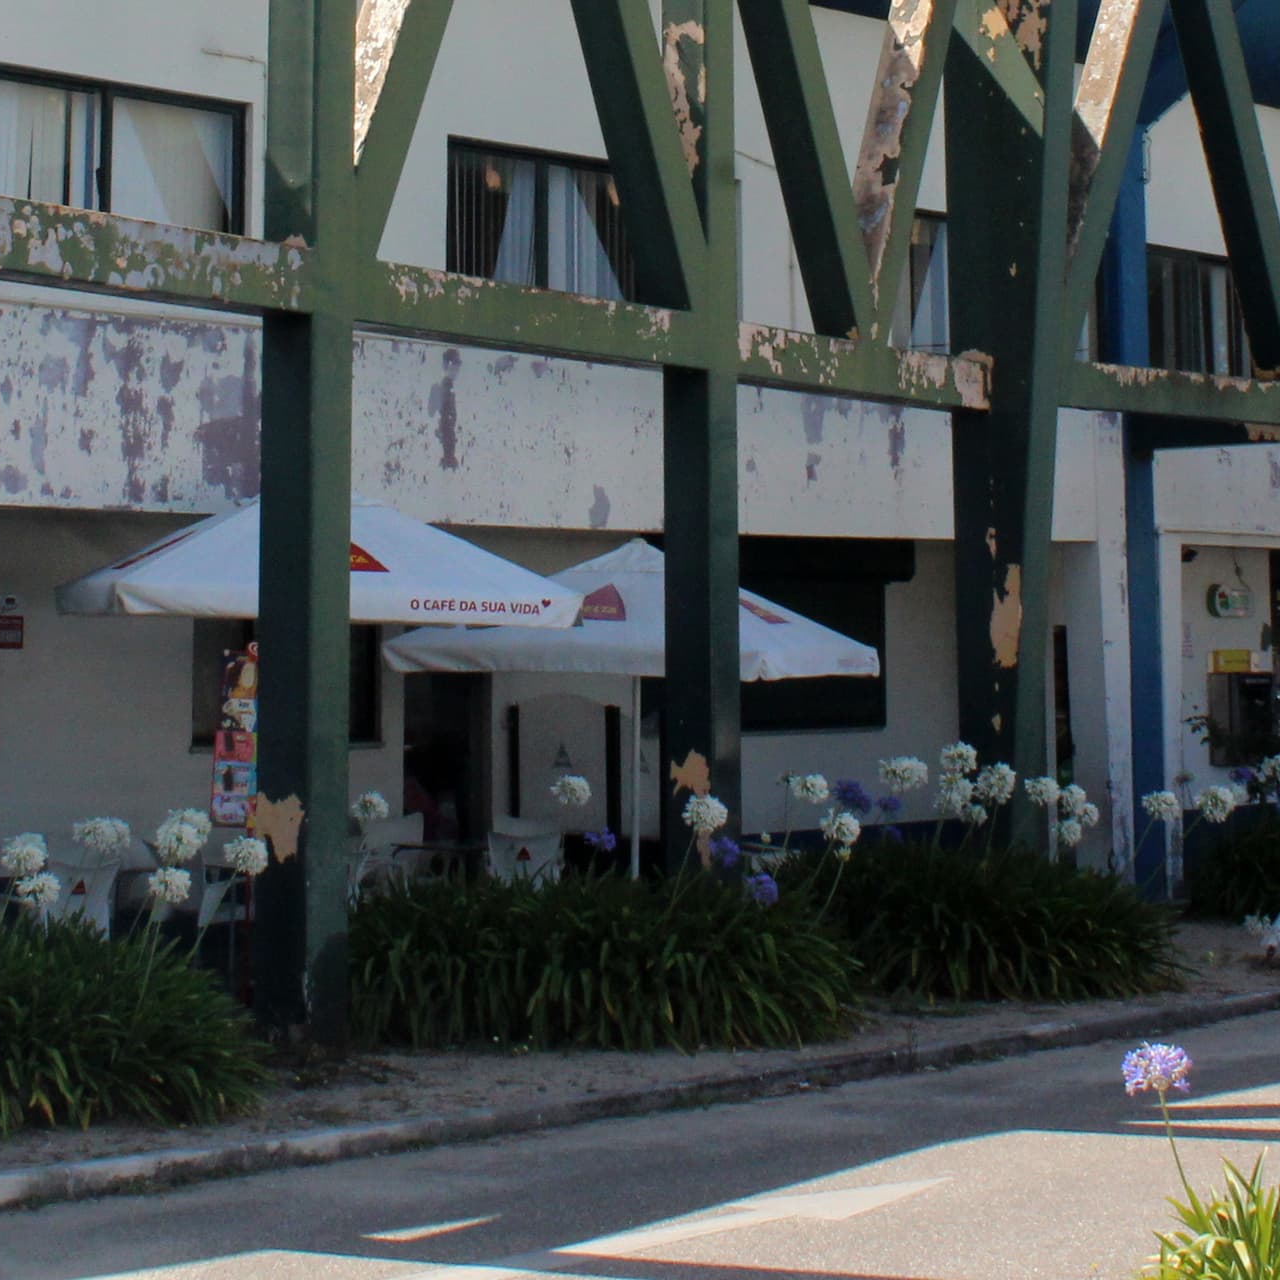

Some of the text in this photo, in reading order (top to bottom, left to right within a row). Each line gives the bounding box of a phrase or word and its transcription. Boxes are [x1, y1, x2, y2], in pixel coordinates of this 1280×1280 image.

[410, 597, 540, 615] O CAFÉ DA SUA VIDA
